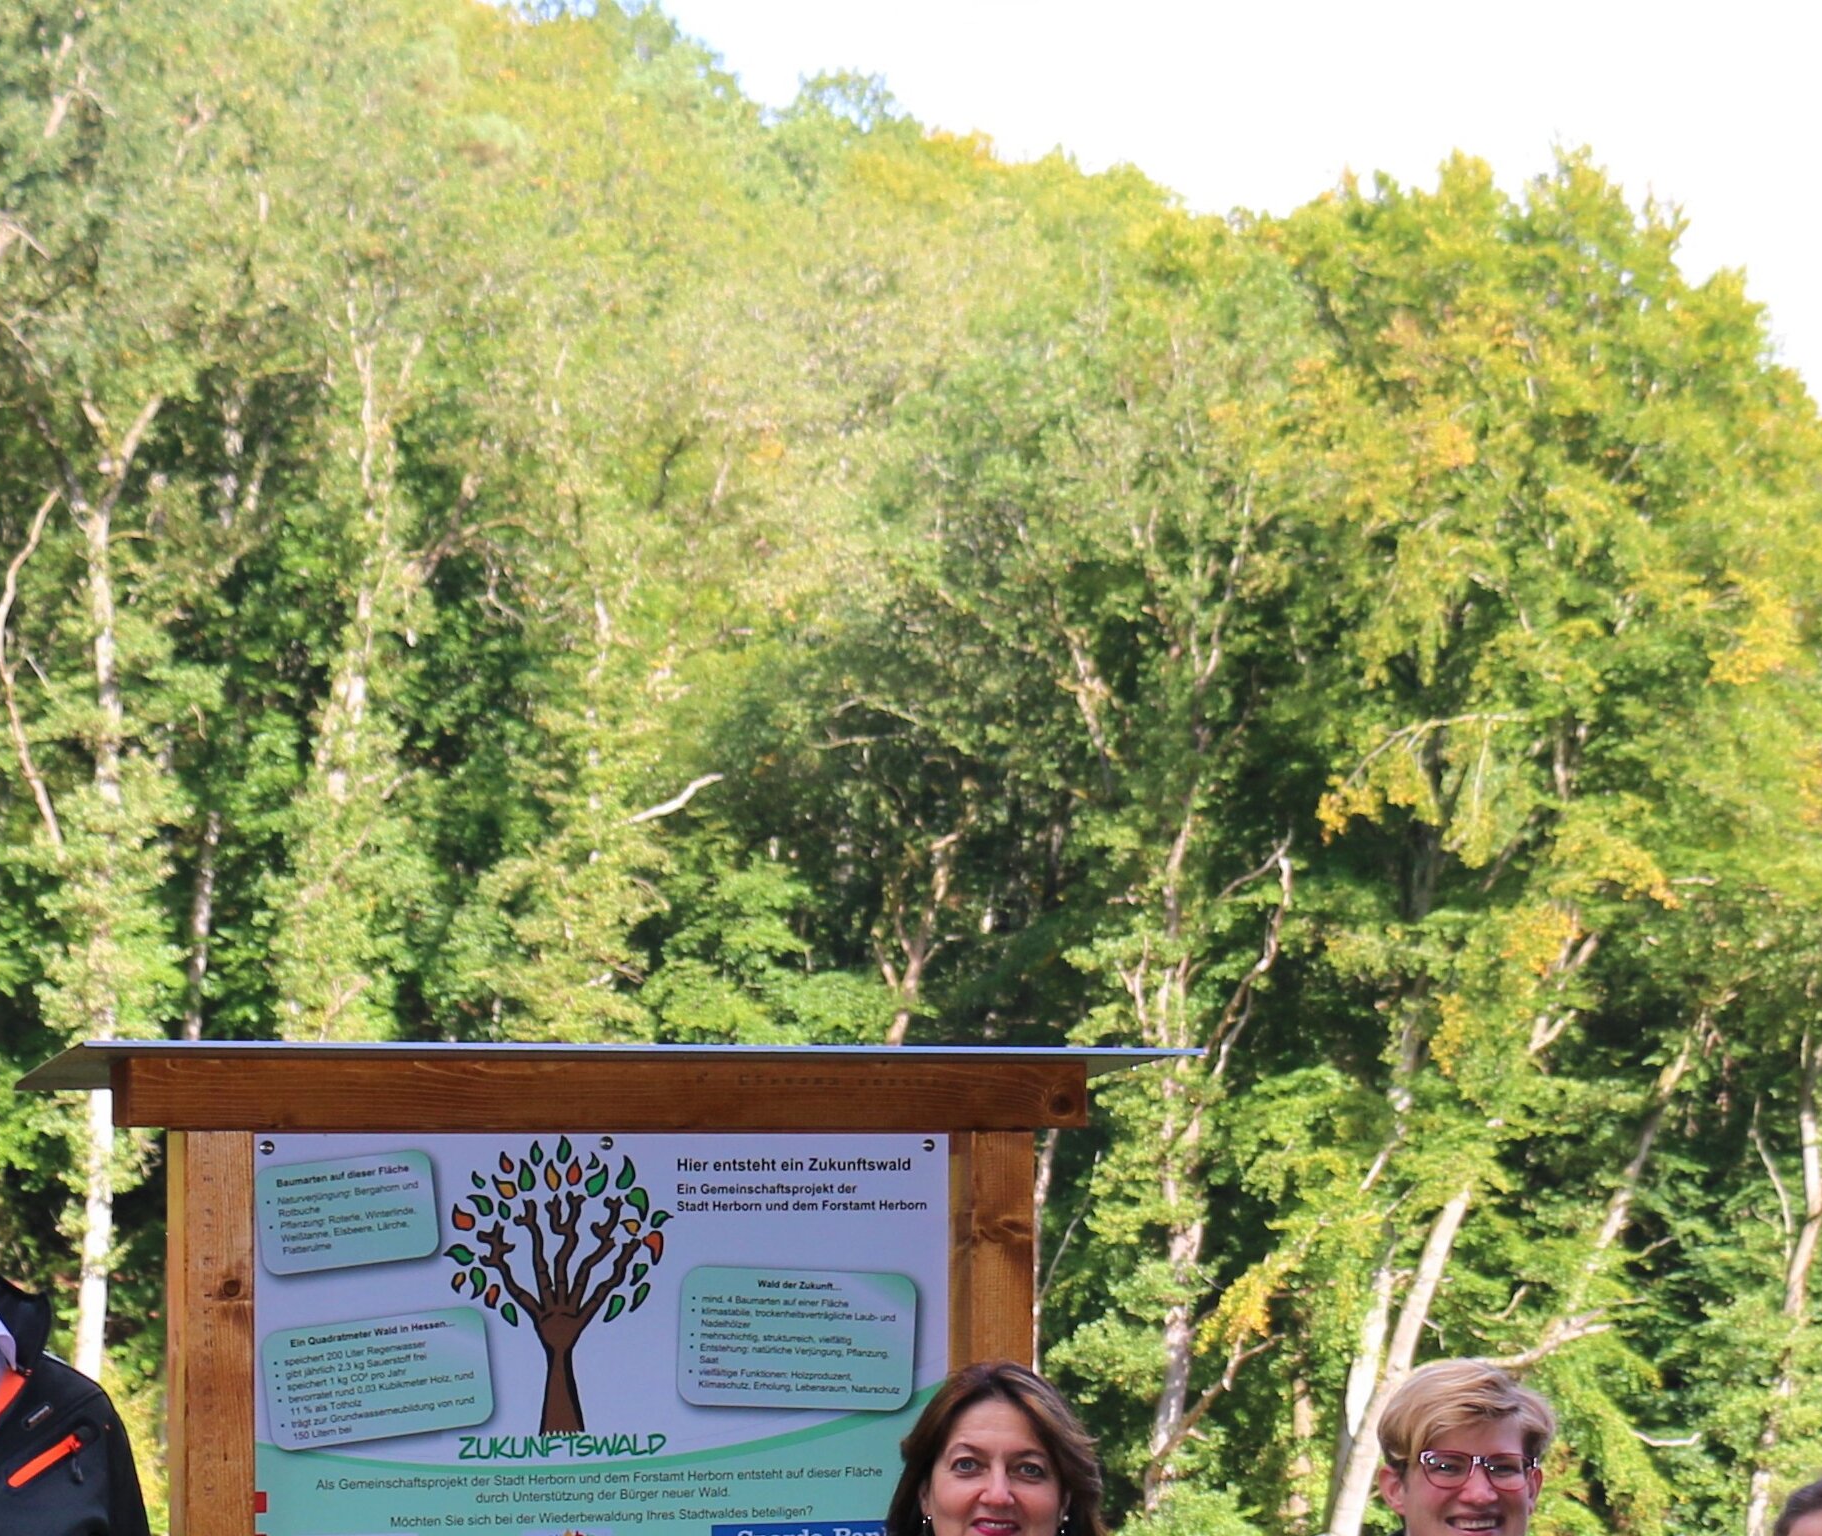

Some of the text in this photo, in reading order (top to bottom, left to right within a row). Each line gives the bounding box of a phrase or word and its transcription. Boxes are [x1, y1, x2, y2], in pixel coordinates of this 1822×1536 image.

[677, 1158, 911, 1172] Hier entsteht ein Zukunftswald
[277, 1165, 409, 1187] Baumarten auf dieser Fläche
[403, 1181, 419, 1190] und
[677, 1183, 857, 1196] Ein Gemeinschaftsprojekt der
[677, 1200, 927, 1211] Stadt Herborn und dem Forstamt Herborn
[758, 1280, 780, 1289] Wald
[782, 1280, 797, 1289] der
[727, 1295, 732, 1303] 4
[736, 1296, 779, 1305] Baumarten
[783, 1297, 796, 1306] auf
[798, 1298, 819, 1307] einer
[822, 1299, 849, 1308] Fläche
[881, 1313, 895, 1322] und
[290, 1338, 305, 1348] Ein
[308, 1330, 372, 1346] Quadratmeter
[374, 1327, 397, 1337] Wald
[400, 1325, 409, 1333] in
[285, 1341, 426, 1367] speichert 200 Liter Regenwasser
[699, 1356, 718, 1365] Saat
[286, 1369, 302, 1381] gibt
[303, 1365, 336, 1379] jährlich
[354, 1361, 365, 1372] kg
[367, 1355, 411, 1368] Sauerstoff
[413, 1353, 427, 1362] frei
[288, 1379, 327, 1392] speichert
[338, 1375, 348, 1386] kg
[371, 1372, 385, 1382] pro
[388, 1368, 407, 1378] Jahr
[335, 1388, 354, 1398] rund
[379, 1377, 428, 1392] Kubikmeter
[454, 1371, 474, 1381] rund
[291, 1399, 362, 1416] 11 % als Totholz
[291, 1417, 311, 1429] trägt
[314, 1416, 328, 1425] zur
[438, 1400, 453, 1409] von
[455, 1396, 475, 1406] rund
[293, 1426, 352, 1441] 150 Litern bei
[458, 1433, 667, 1460] ZUKUNFTSWALD
[317, 1466, 883, 1490] Als Gemeinschaftsprojekt der Stadt Herborn und dem Forstamt Herborn entsteht auf dieser Fläche
[476, 1487, 730, 1504] durch Unterstützung der Bürger neuer Wald.
[390, 1506, 813, 1528] Möchten Sie sich bei der Wiederbewaldung Ihres Stadtwaldes beteiligen?
